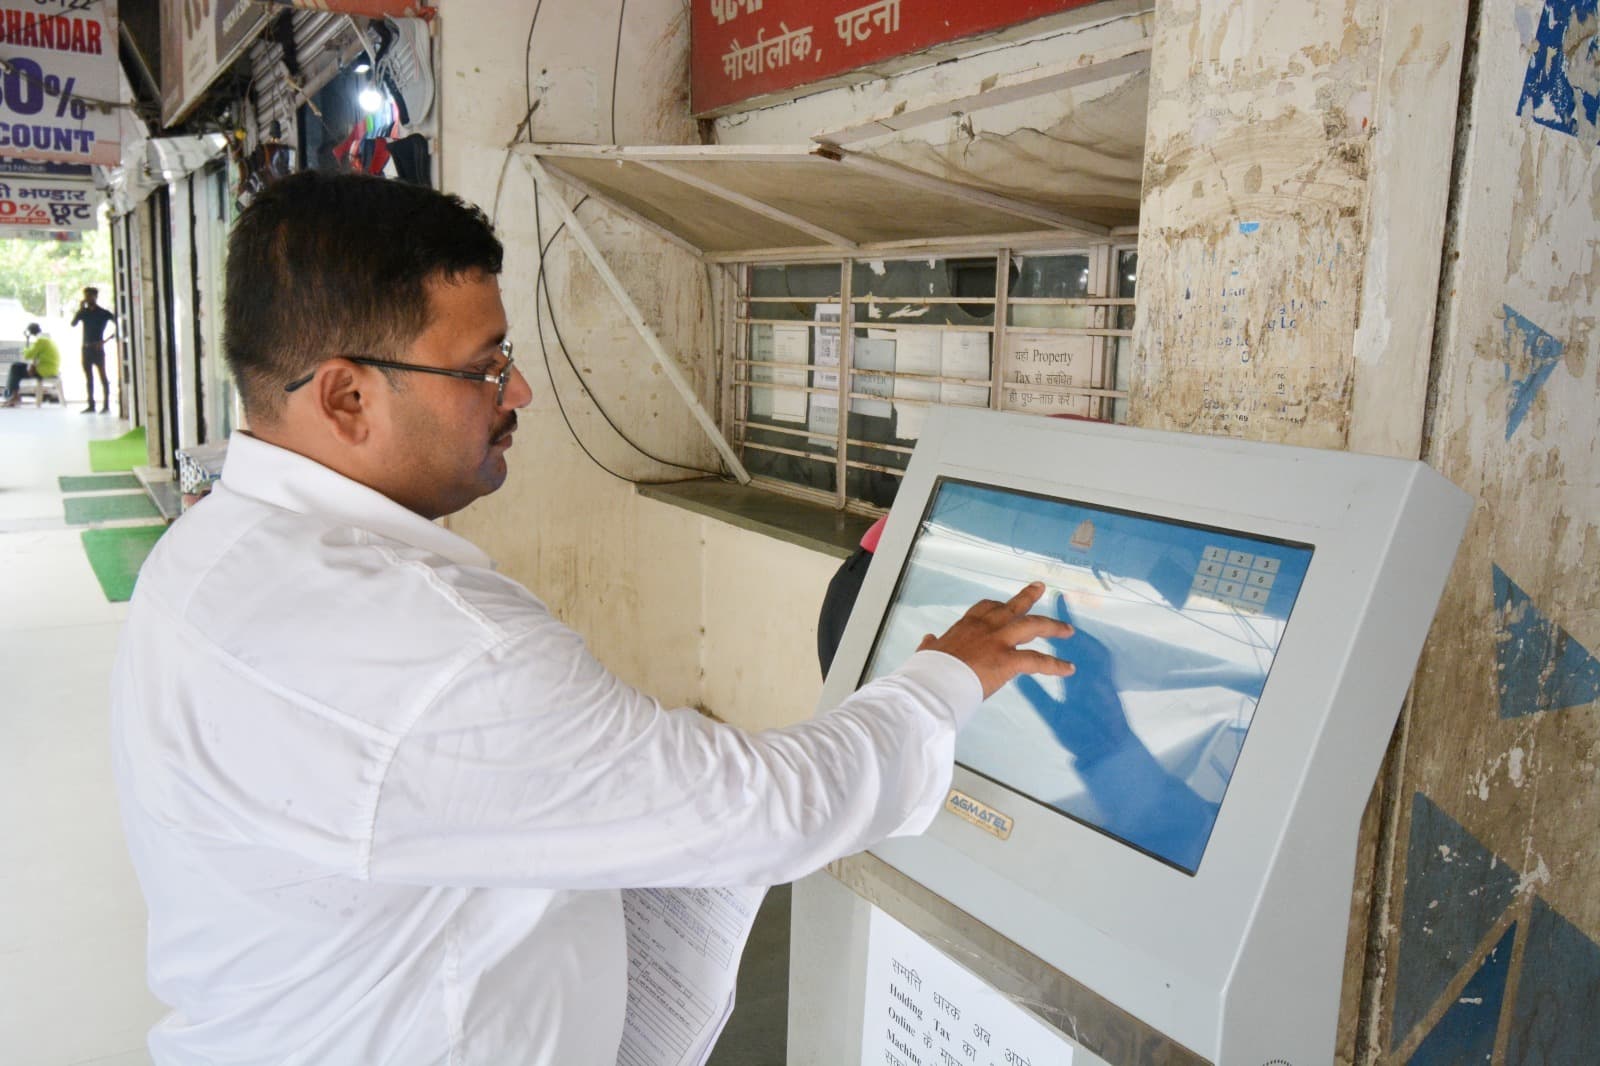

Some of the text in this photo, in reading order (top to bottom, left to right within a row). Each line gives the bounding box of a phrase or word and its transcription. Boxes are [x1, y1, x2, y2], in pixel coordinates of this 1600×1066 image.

[722, 0, 900, 81] मौर्यालोक, पटना
[0, 57, 86, 120] 0%
[0, 121, 95, 154] COUNT
[48, 203, 91, 226] छूट
[1033, 349, 1073, 366] Property
[1015, 370, 1031, 384] Tax
[1212, 549, 1270, 569] 1 2 3
[1206, 564, 1265, 584] 4 5 6
[950, 794, 1008, 832] AGMATEL
[888, 1006, 917, 1037] Online
[889, 983, 976, 1062] Holding Tax का
[973, 1023, 991, 1047] अब
